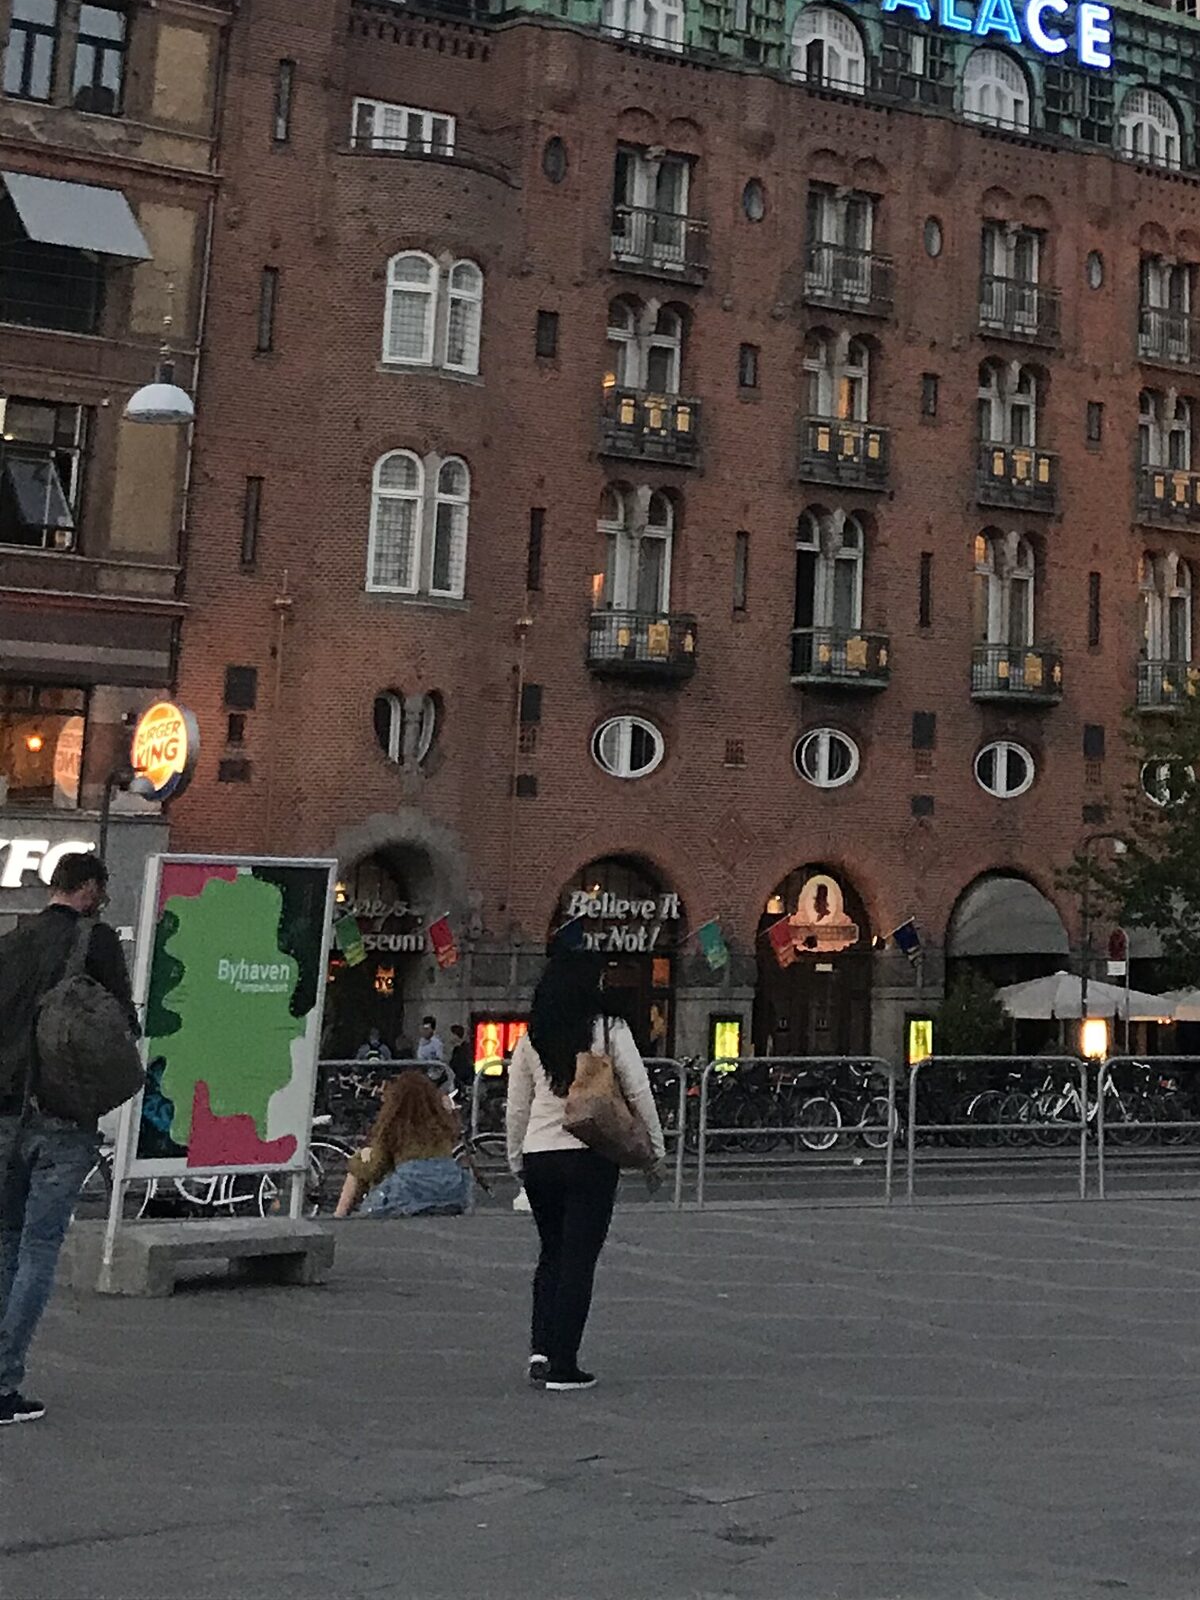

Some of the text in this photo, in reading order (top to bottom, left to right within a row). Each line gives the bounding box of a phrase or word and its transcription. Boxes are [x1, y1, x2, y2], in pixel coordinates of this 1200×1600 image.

[137, 720, 181, 749] BURGER
[136, 738, 179, 769] KING
[0, 839, 96, 888] FC
[566, 889, 681, 920] Believe It
[606, 924, 661, 952] Not!
[217, 957, 290, 984] Byhaven
